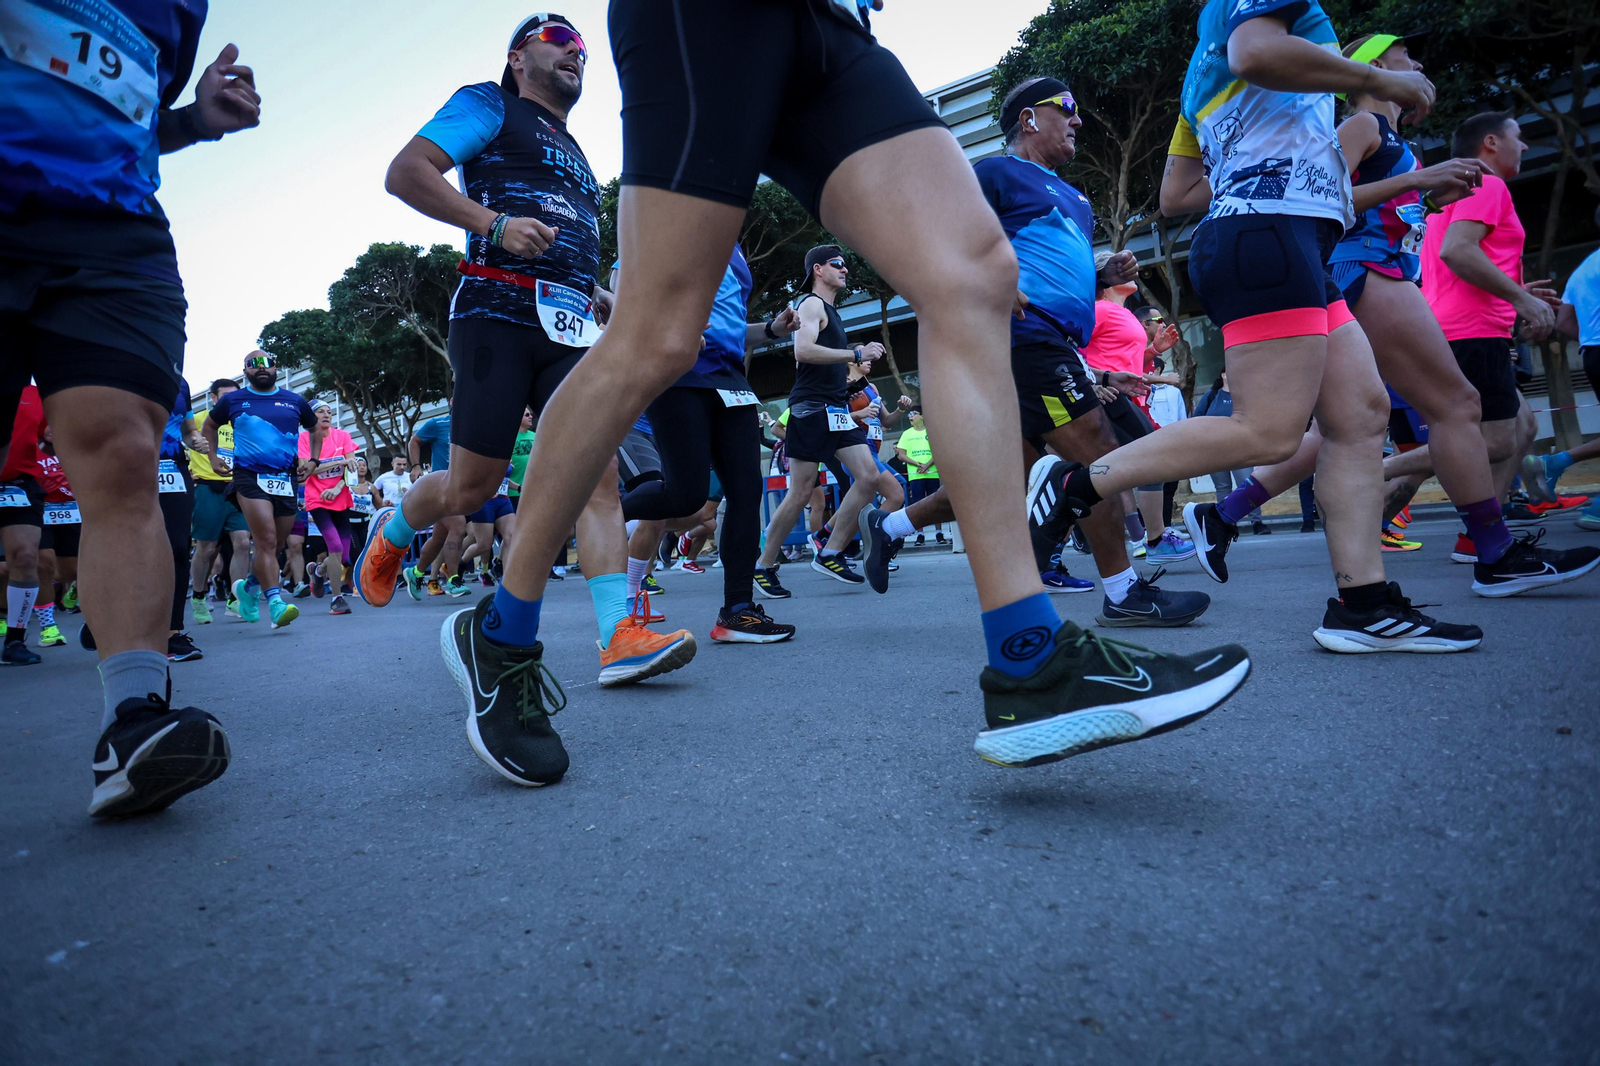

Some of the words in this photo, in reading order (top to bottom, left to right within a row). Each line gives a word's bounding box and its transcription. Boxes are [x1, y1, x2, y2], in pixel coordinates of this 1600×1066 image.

[69, 31, 123, 80] 19
[1295, 159, 1328, 180] Estella
[1327, 175, 1337, 190] del
[540, 203, 577, 221] TRIACADEMY
[548, 285, 562, 294] XLIII
[562, 289, 580, 301] Carrera
[554, 295, 574, 305] Ciudad
[554, 310, 584, 338] 847
[49, 510, 72, 519] 968
